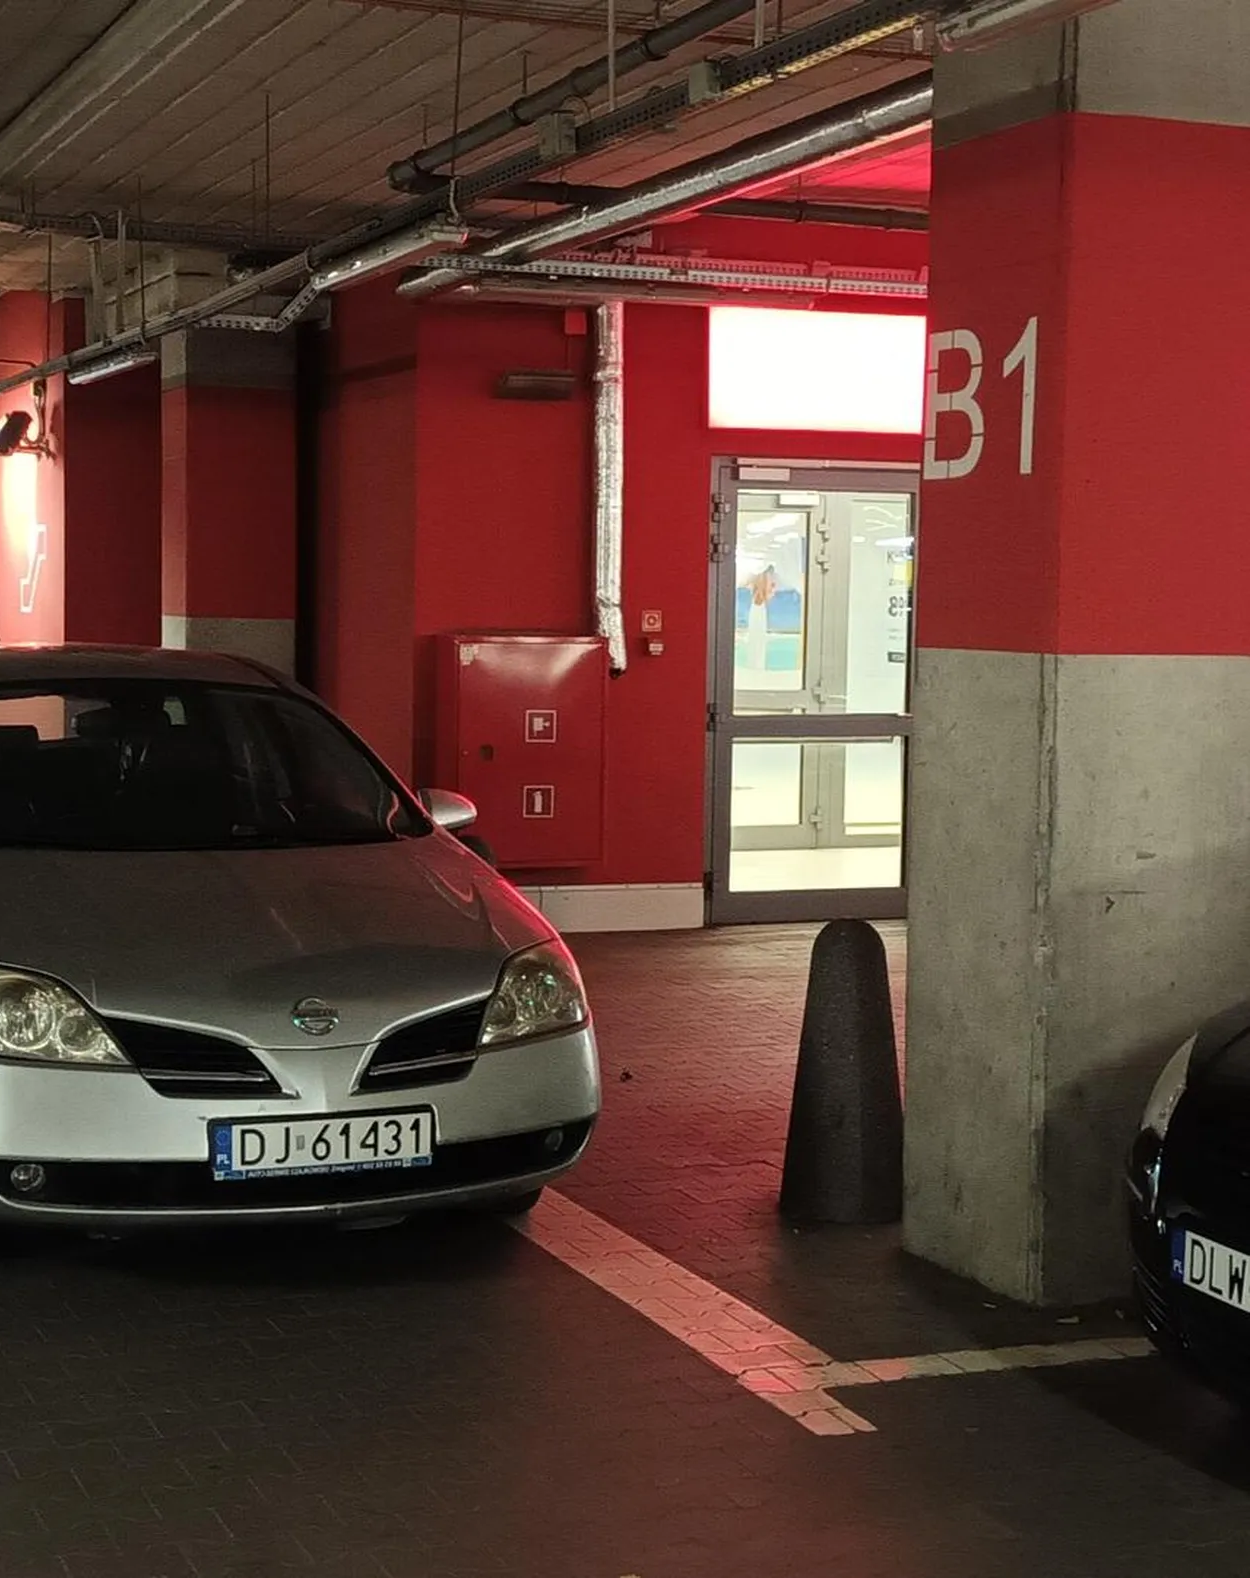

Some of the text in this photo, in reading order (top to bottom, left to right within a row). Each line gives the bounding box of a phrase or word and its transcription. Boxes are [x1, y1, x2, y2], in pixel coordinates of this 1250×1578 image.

[923, 316, 1038, 480] B1
[216, 1153, 231, 1166] PL
[240, 1118, 421, 1166] DJ 61431
[1189, 1238, 1247, 1305] DLW
